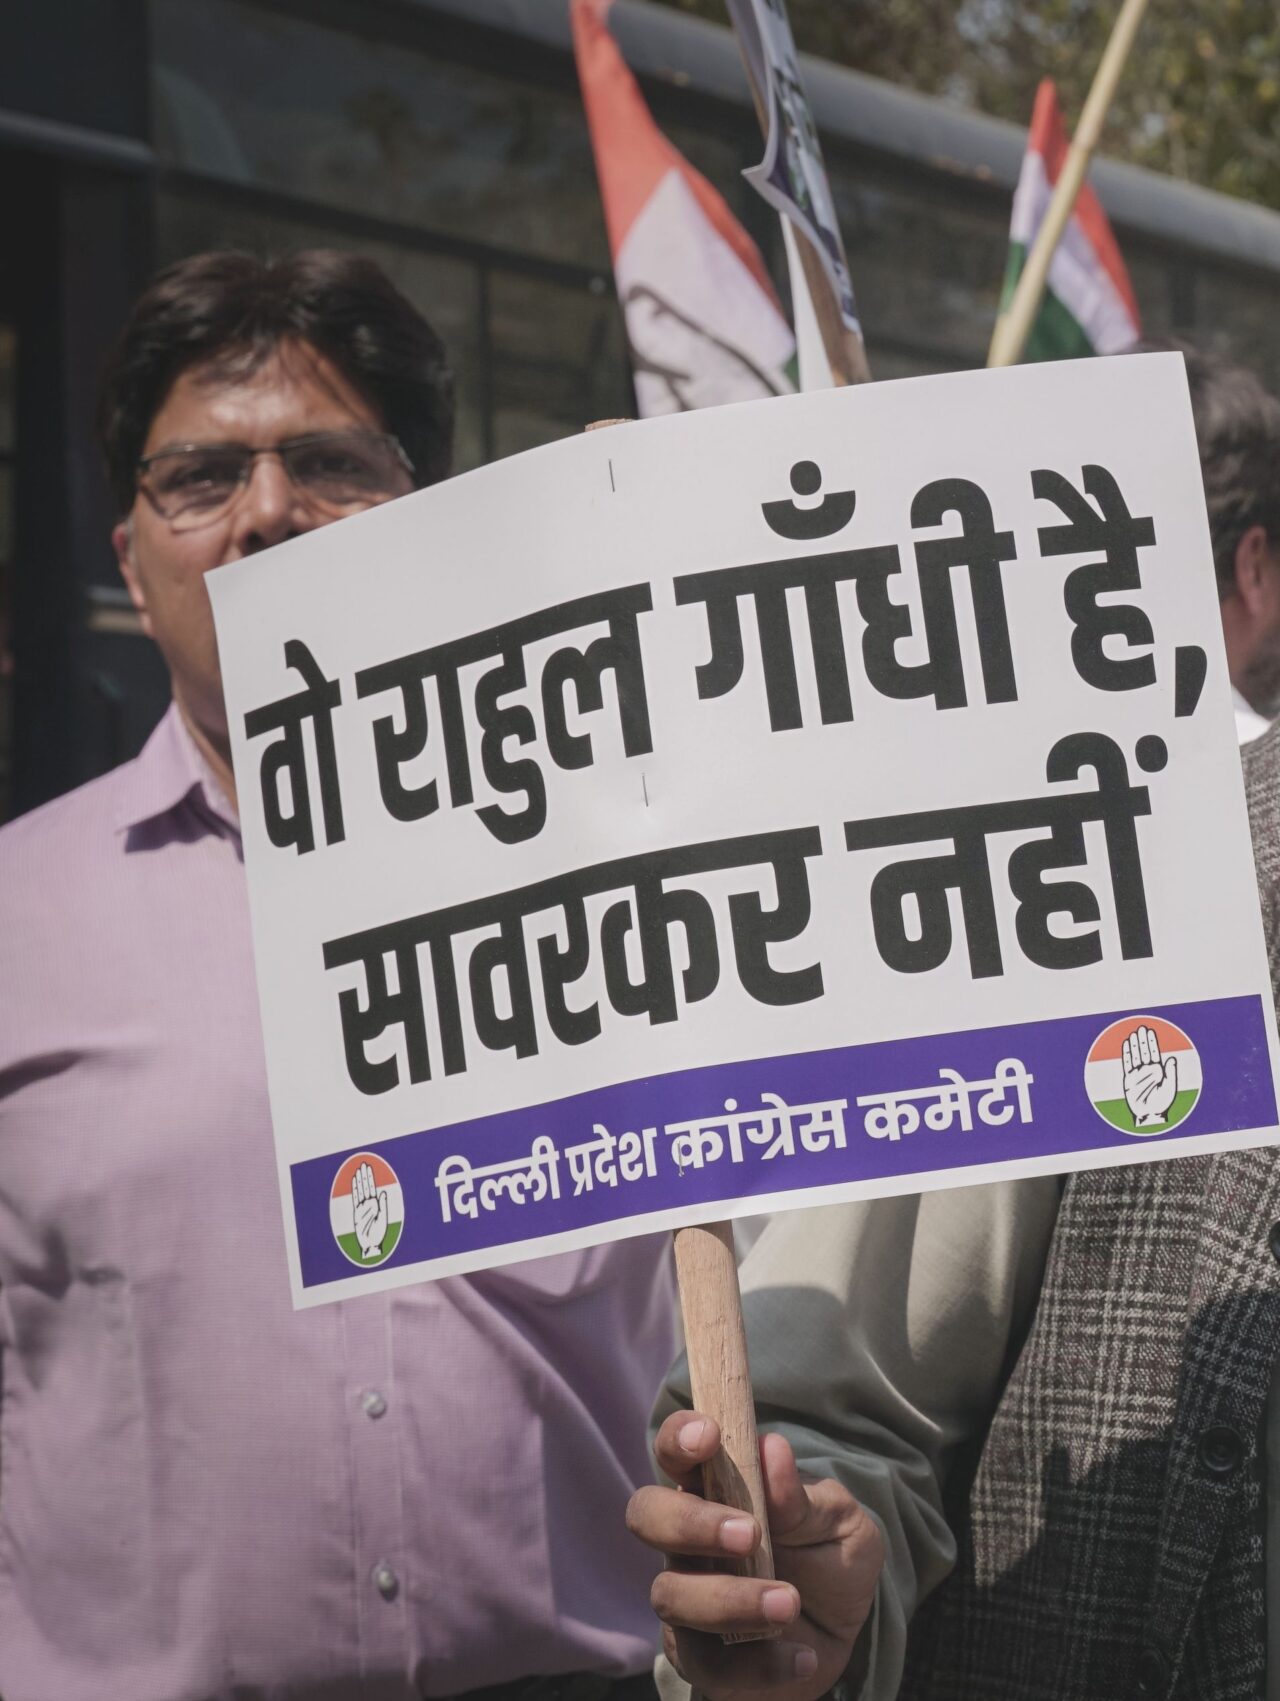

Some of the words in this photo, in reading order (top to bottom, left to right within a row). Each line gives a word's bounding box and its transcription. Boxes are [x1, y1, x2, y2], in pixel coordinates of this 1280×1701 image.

[244, 640, 345, 856] वो
[355, 581, 654, 844] राहुल
[673, 460, 1018, 732] गाँधी
[1031, 464, 1208, 718] है,
[322, 825, 824, 1095] सावरकर
[844, 731, 1169, 980] नहीं
[434, 1135, 560, 1223] दिल्ली
[564, 1124, 658, 1196] प्रदेश
[664, 1092, 848, 1177] कांग्रेस
[856, 1057, 1035, 1142] कमेटी
